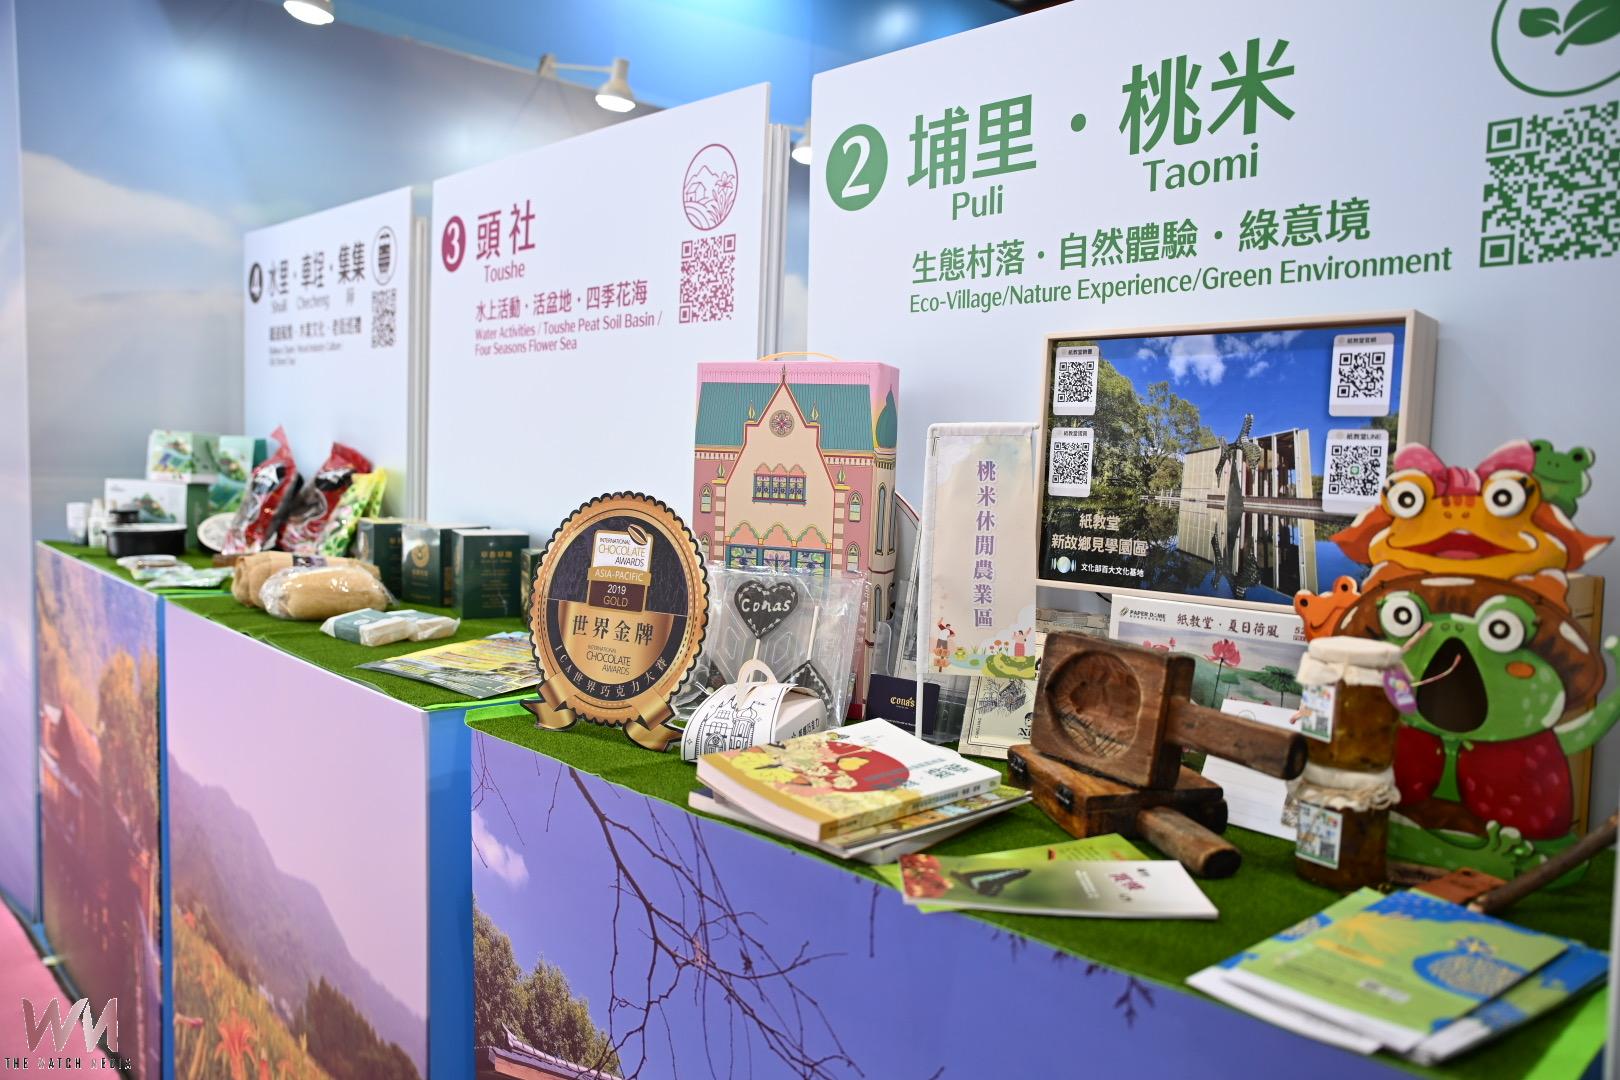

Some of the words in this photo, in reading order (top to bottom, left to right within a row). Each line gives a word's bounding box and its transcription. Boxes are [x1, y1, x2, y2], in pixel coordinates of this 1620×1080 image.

[952, 184, 1003, 220] Puli
[1143, 142, 1258, 192] Taomi
[476, 199, 536, 260] 頭社
[484, 260, 526, 283] Toushe
[910, 284, 1071, 313] Eco-Village/Nature
[1077, 267, 1272, 304] Experience/Green
[1280, 248, 1453, 283] Environment
[475, 327, 497, 341] Water
[500, 323, 536, 339] Activities
[543, 320, 576, 334] Toushe
[578, 318, 600, 332] Peat
[602, 314, 622, 330] Soil
[625, 312, 655, 328] Basin
[475, 344, 492, 357] Four
[494, 341, 527, 355] Seasons
[528, 338, 558, 352] Flower
[560, 337, 577, 350] Sea
[1079, 511, 1121, 531] 紙教堂
[599, 544, 646, 557] CHOCOLATE
[600, 537, 631, 546] INTERNATIONAL
[973, 460, 997, 628] 桃米休閒農業區
[1051, 533, 1149, 557] 新故鄉見學園區
[614, 556, 645, 567] AWARDS
[1081, 563, 1145, 578] 文化部百大文化基地
[607, 583, 627, 595] 2019
[603, 595, 628, 607] GOLD
[1129, 609, 1148, 617] PAPER
[572, 614, 653, 646] 世界金牌
[586, 650, 631, 667] CHOCOLATE
[602, 664, 630, 675] AWARDS
